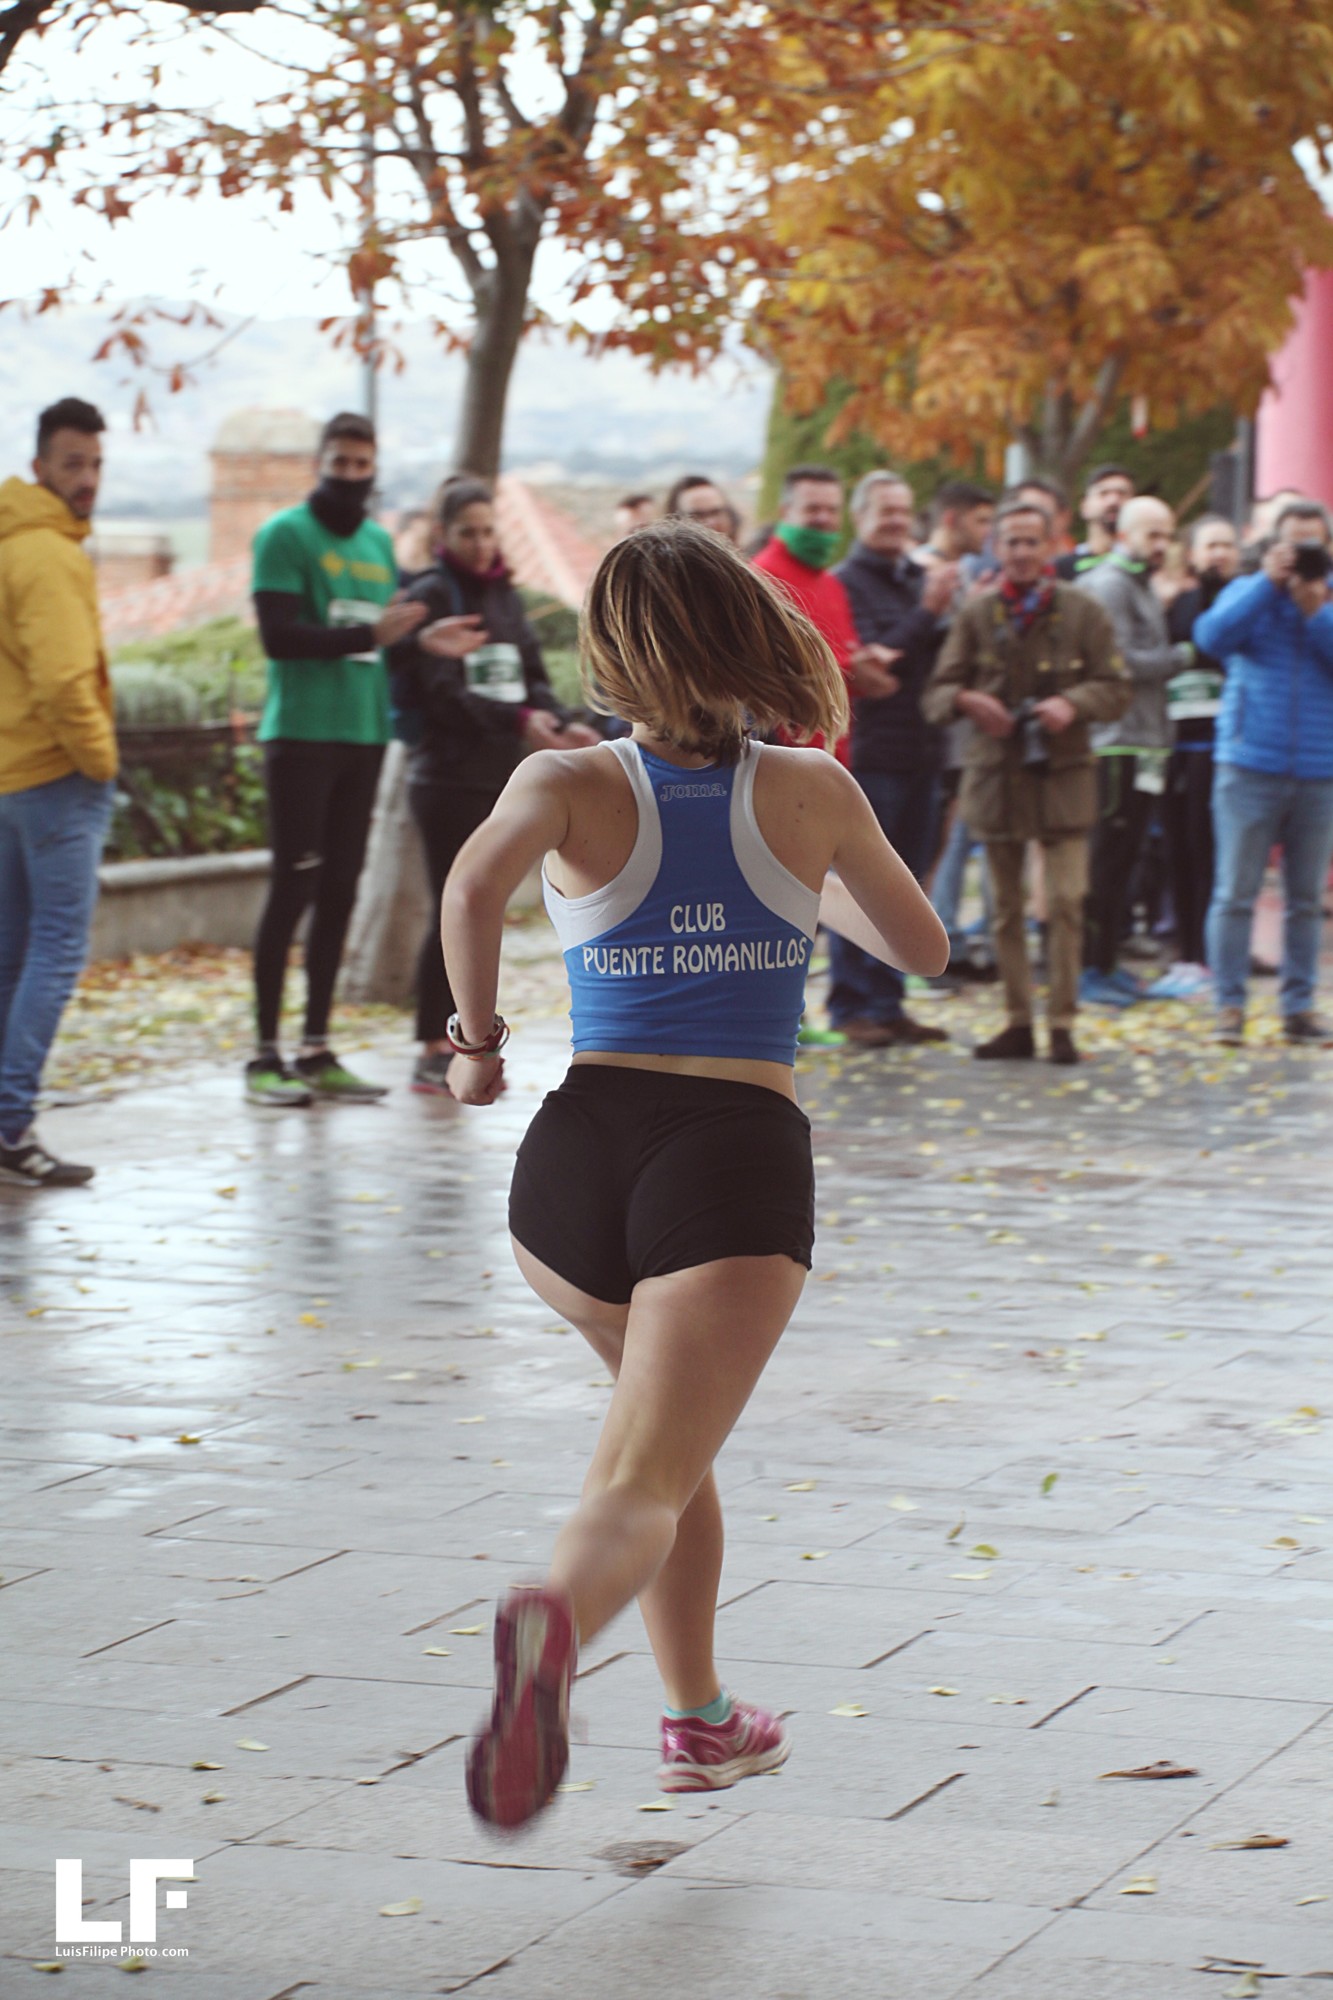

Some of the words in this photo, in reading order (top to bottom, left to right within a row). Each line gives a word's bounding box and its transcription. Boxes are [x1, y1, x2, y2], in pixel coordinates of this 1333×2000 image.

[670, 902, 726, 934] CLUB
[582, 945, 665, 976] PUENTE
[673, 936, 808, 974] ROMANILLOS
